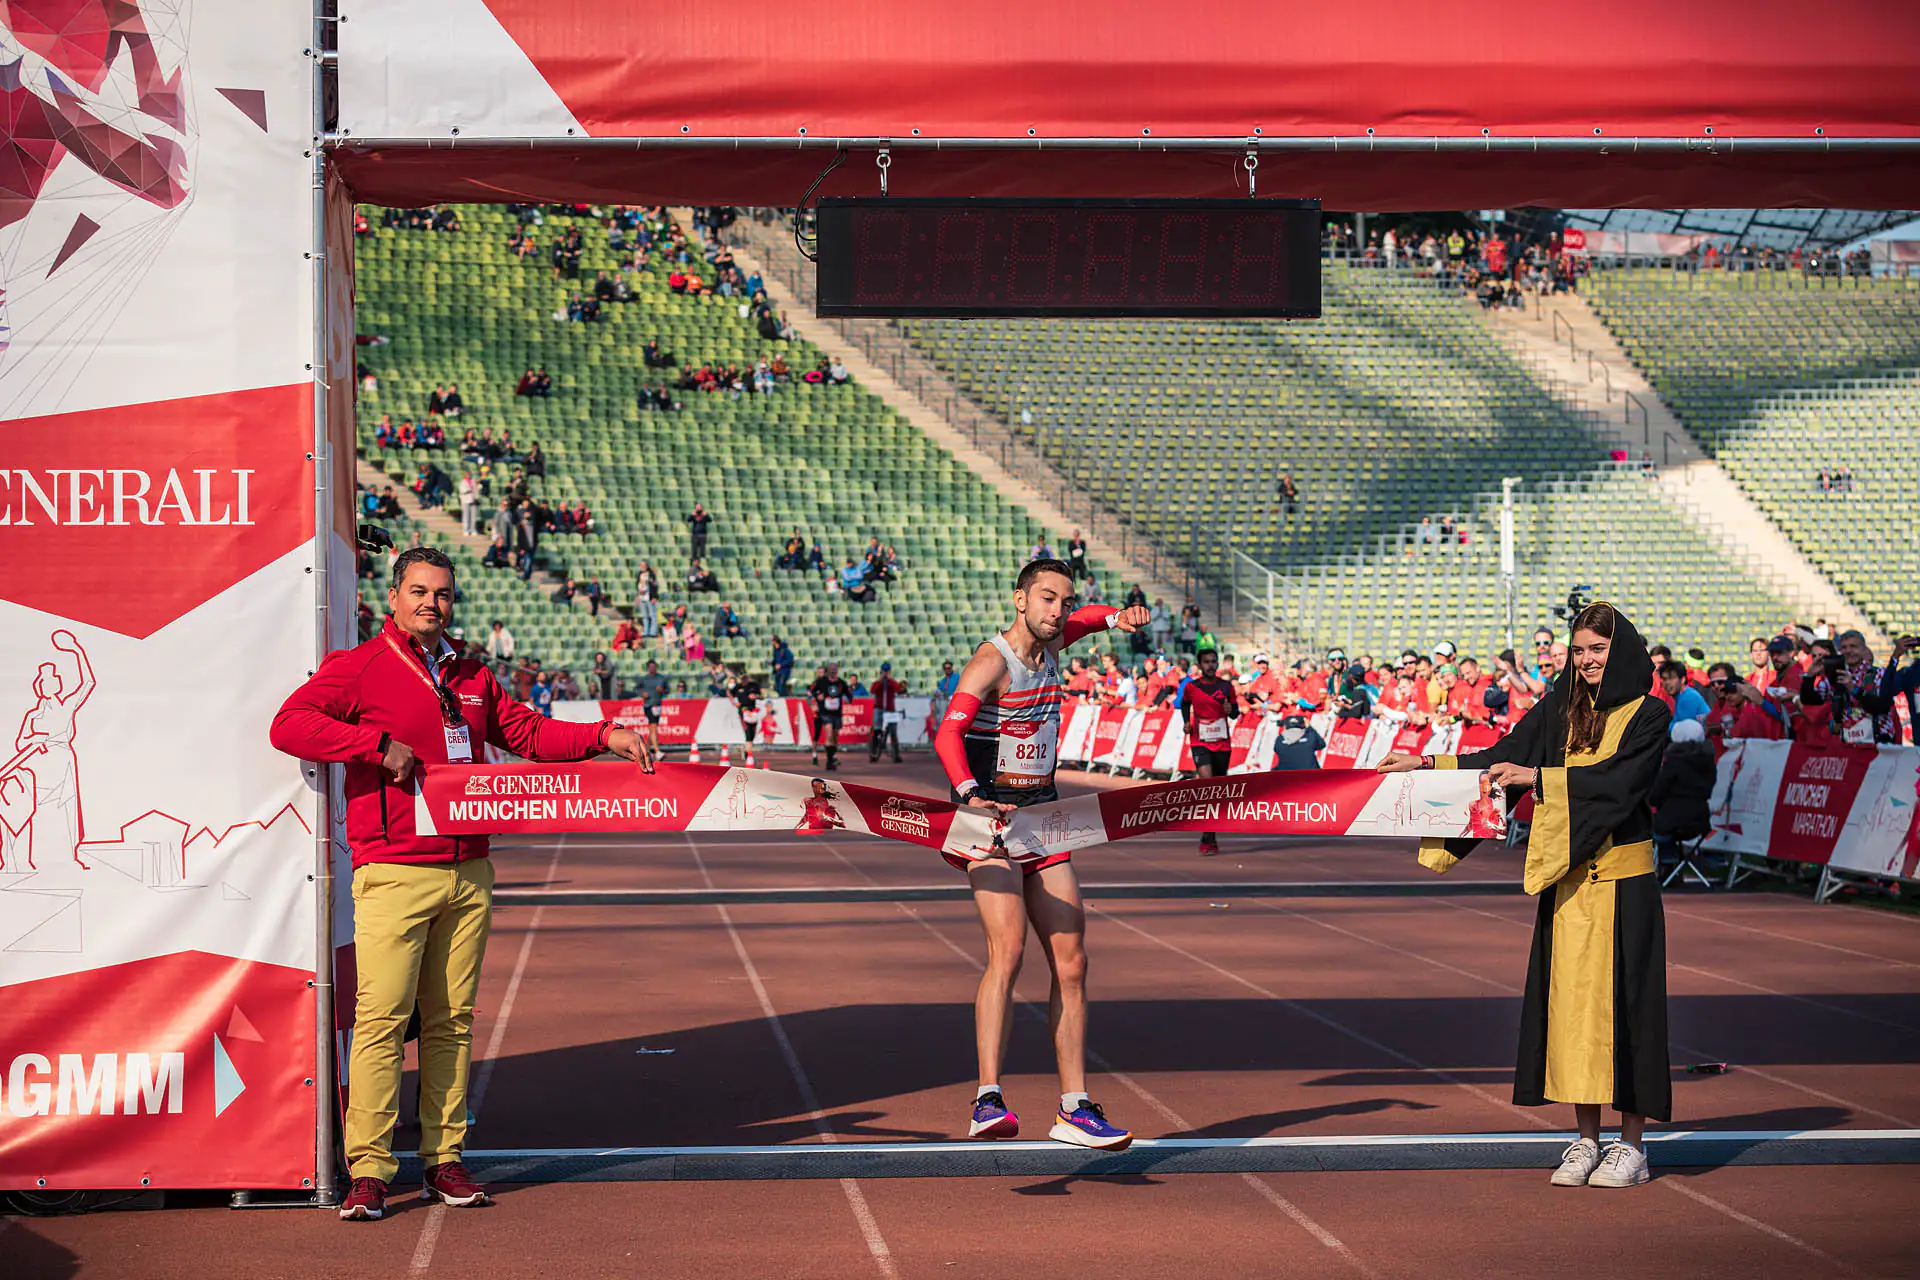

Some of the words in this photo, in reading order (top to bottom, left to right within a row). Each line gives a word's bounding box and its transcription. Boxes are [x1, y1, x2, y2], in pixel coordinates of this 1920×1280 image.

[0, 468, 255, 525] NERALI
[448, 735, 468, 744] CREW
[999, 758, 1006, 767] A
[1015, 743, 1047, 760] 8212
[493, 774, 581, 795] GENERALI
[1166, 782, 1247, 805] GENERALI
[449, 799, 557, 821] MÜNCHEN
[565, 797, 678, 819] MARATHON
[1121, 801, 1220, 829] MÜNCHEN
[1227, 801, 1337, 823] MARATHON
[881, 819, 930, 838] GENERALI
[0, 1052, 185, 1118] GMM
